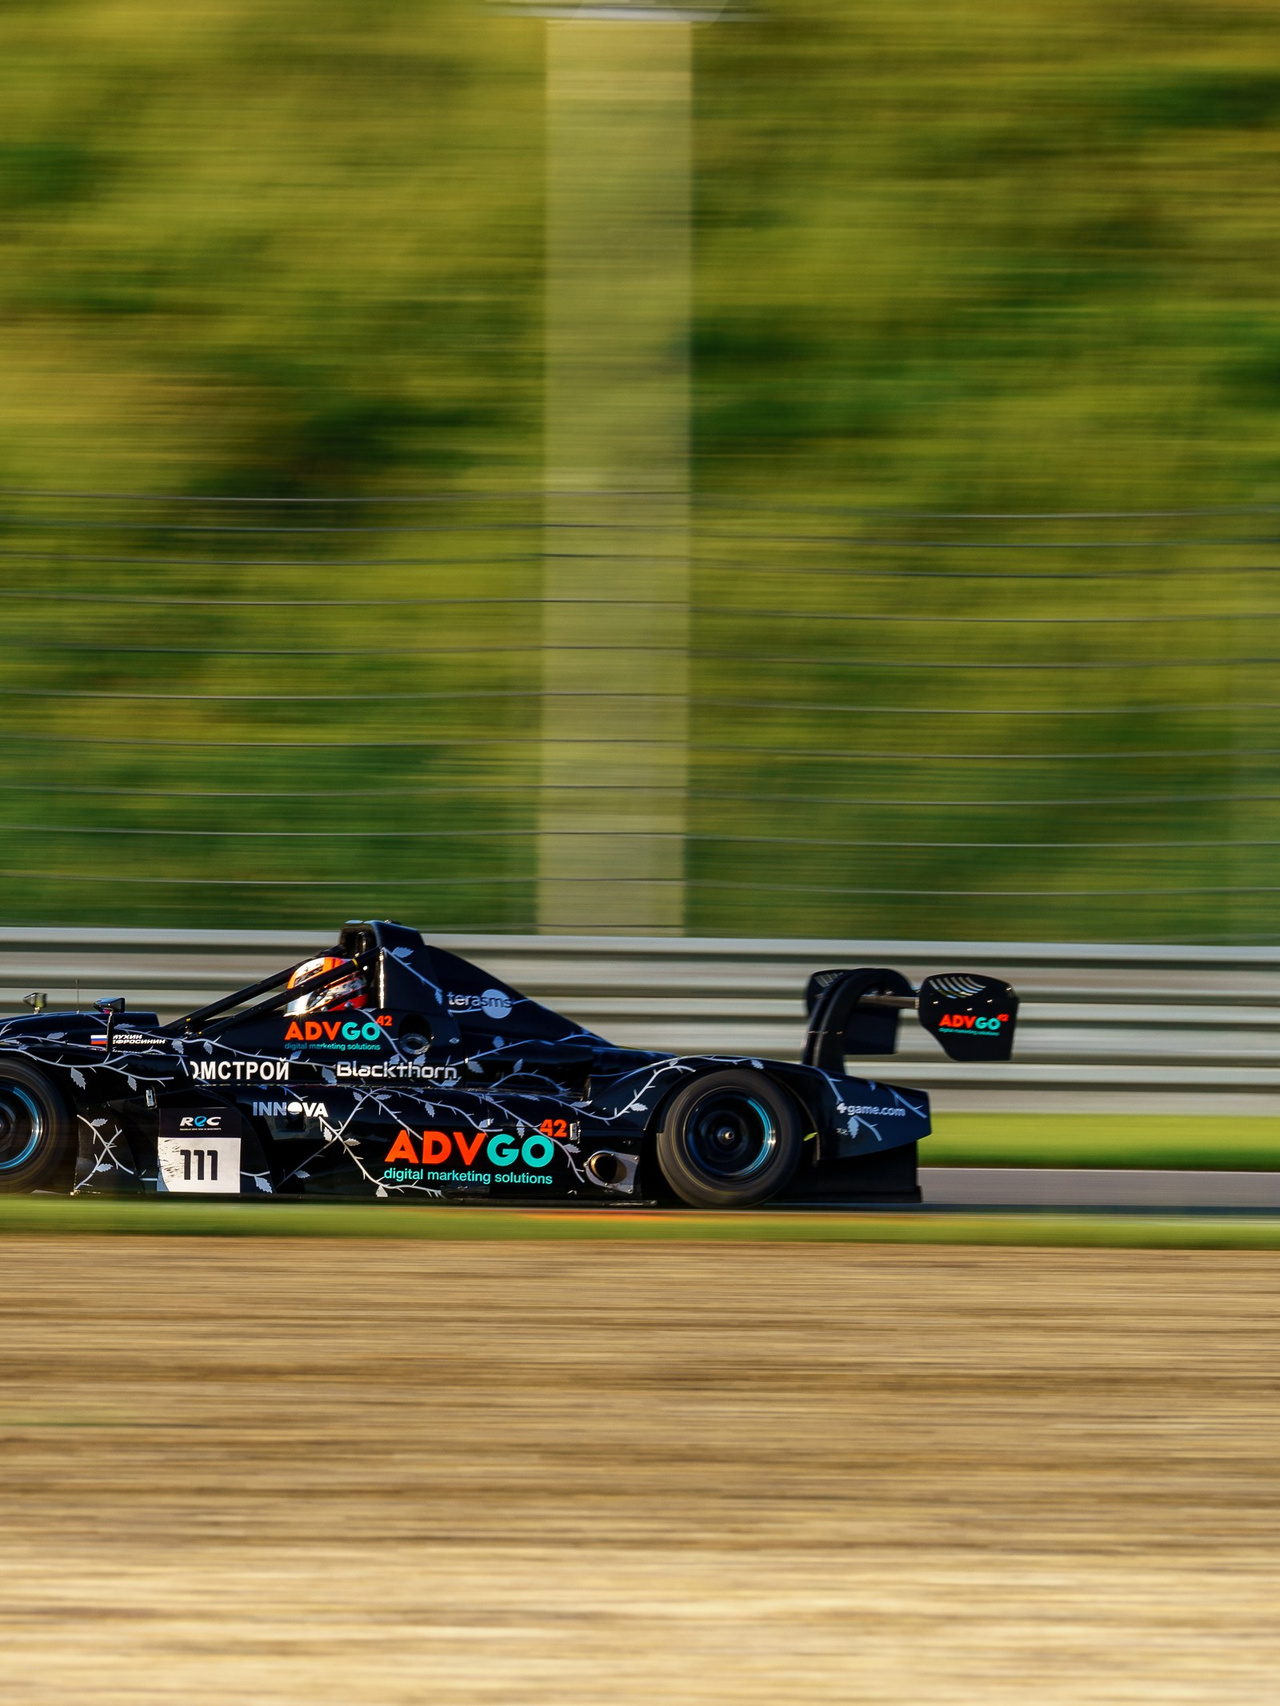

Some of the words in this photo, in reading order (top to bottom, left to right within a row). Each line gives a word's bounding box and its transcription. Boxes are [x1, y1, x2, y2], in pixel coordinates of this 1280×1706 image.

[447, 992, 513, 1009] terasms
[284, 1021, 381, 1041] ADVGO
[376, 1015, 393, 1026] 42
[939, 1014, 1001, 1031] ADVGO
[284, 1042, 308, 1051] digital
[309, 1043, 346, 1051] marketing
[347, 1043, 381, 1051] solutions
[336, 1060, 457, 1079] Blackthorn
[252, 1101, 329, 1118] INNOVA
[836, 1102, 906, 1116] 4game.com
[384, 1130, 554, 1168] ADVGO
[539, 1119, 568, 1138] 42
[180, 1149, 218, 1181] 111
[383, 1167, 424, 1182] digital
[427, 1169, 491, 1185] marketing
[494, 1172, 553, 1185] solutions
